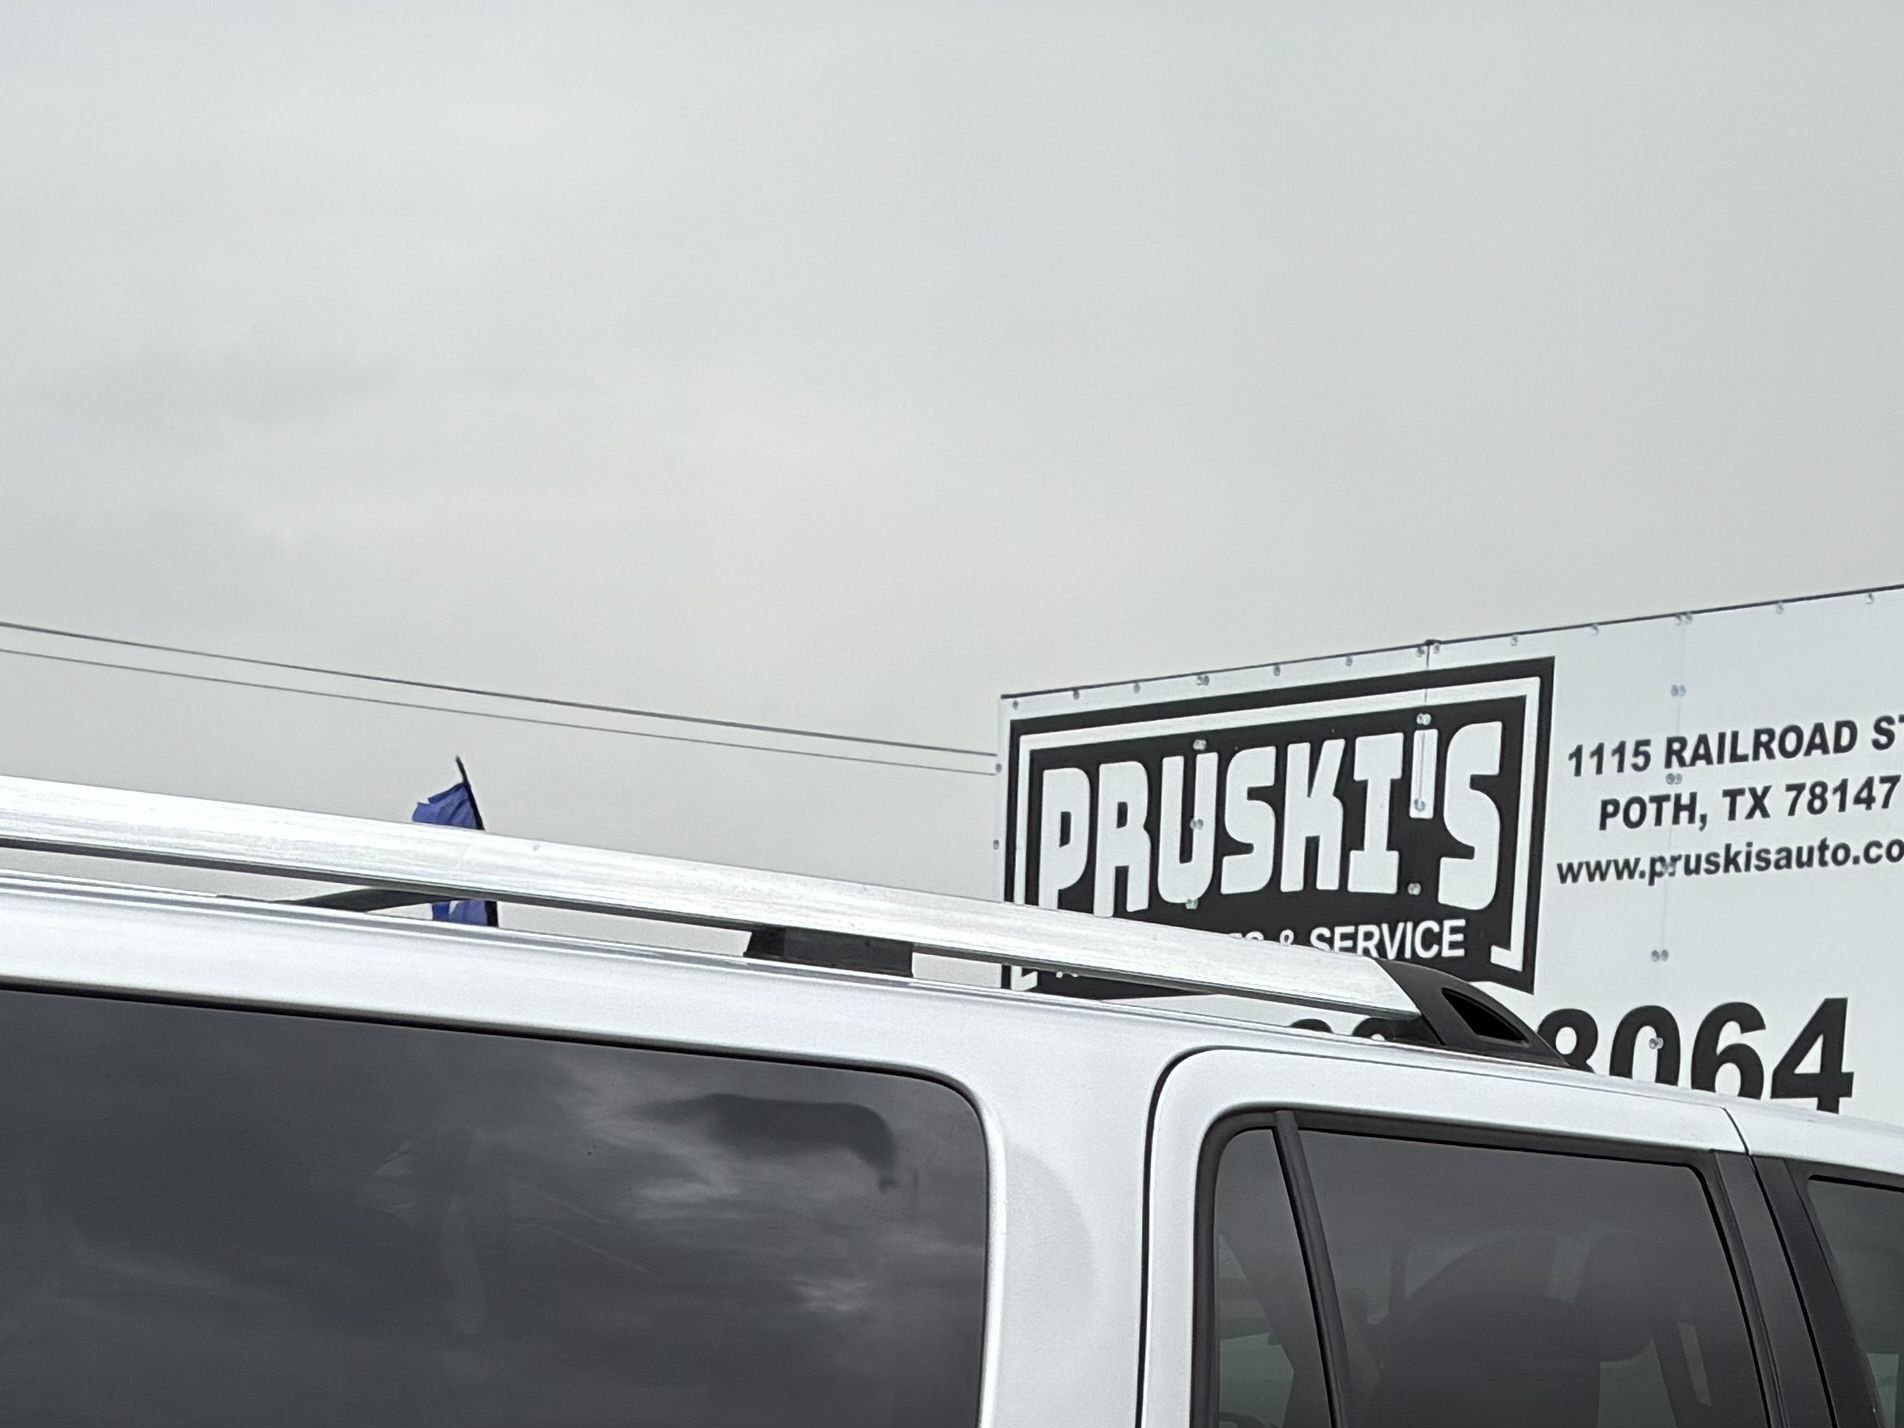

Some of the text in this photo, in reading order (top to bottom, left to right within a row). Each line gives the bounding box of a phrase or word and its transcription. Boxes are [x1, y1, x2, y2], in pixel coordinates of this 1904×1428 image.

[1567, 738, 1652, 778] 1115
[1664, 719, 1858, 770] RAILROAD
[1038, 720, 1503, 918] PRUSKI'S
[1599, 774, 1902, 832] POTH, TX 78147
[1309, 918, 1467, 960] SERVICE
